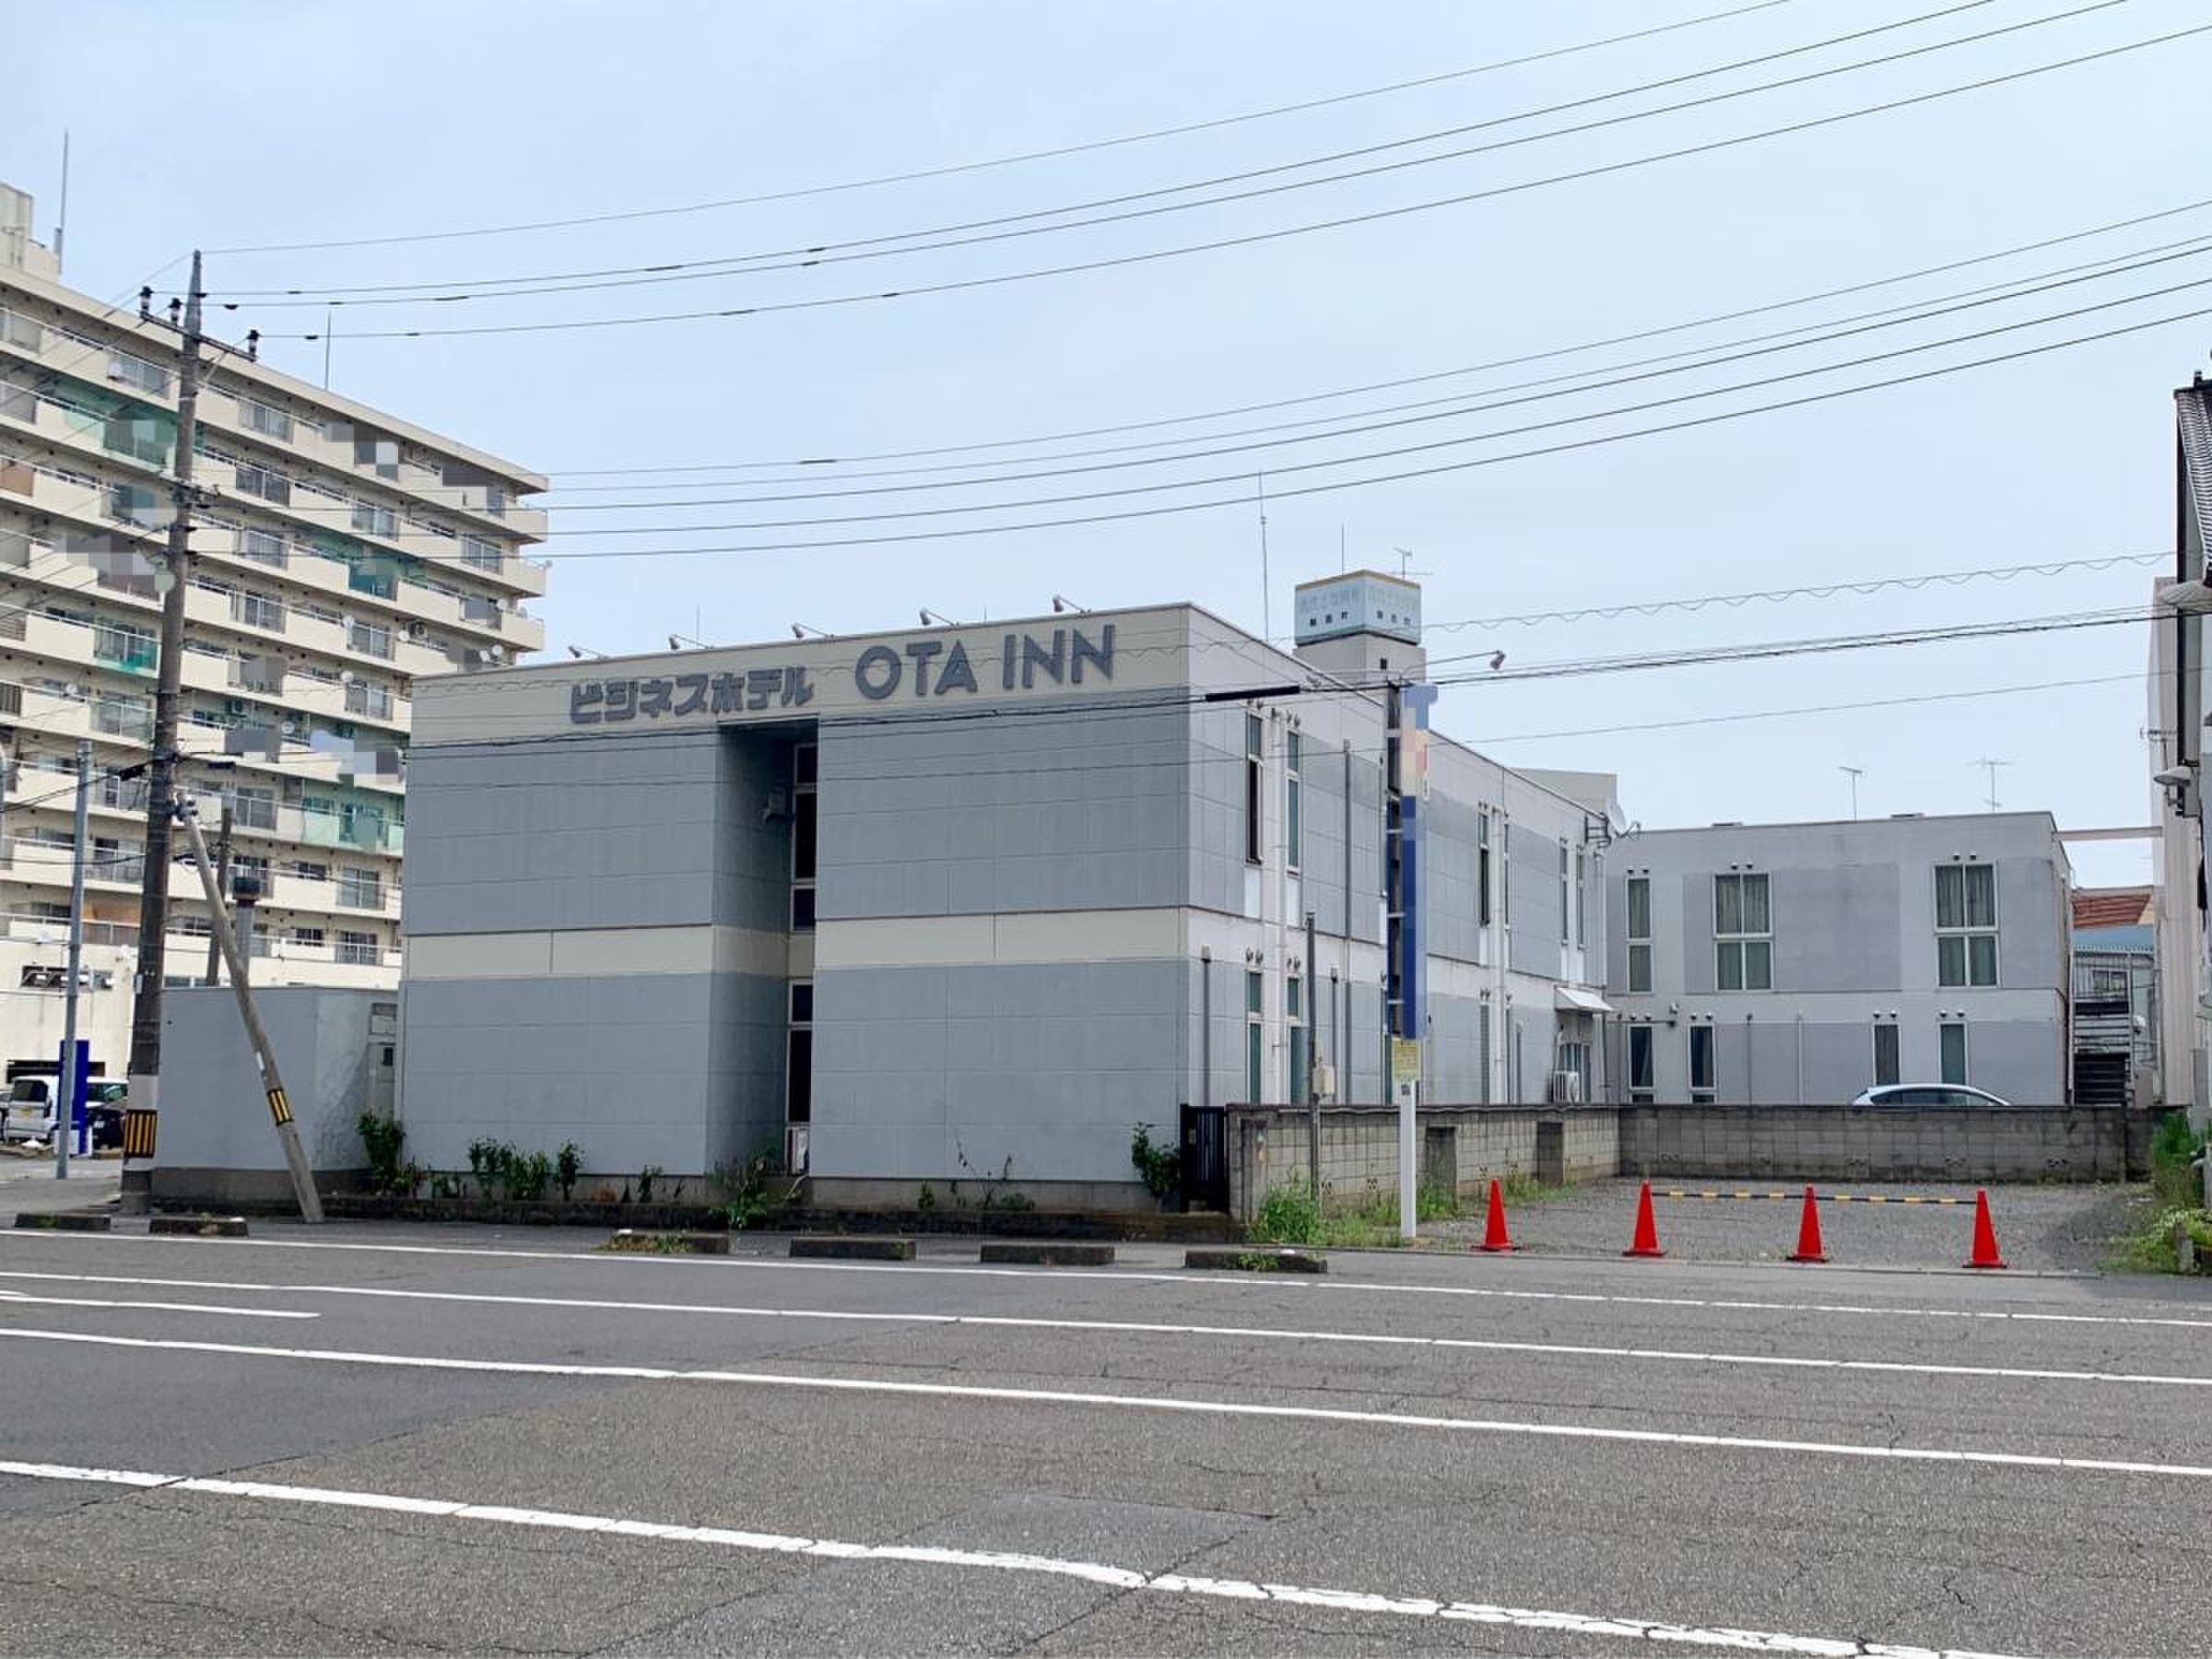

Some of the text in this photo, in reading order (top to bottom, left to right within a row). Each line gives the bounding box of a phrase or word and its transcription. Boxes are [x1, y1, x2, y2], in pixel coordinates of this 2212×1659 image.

[571, 666, 814, 724] ビジネスホテル
[855, 625, 1115, 700] OTA INN
